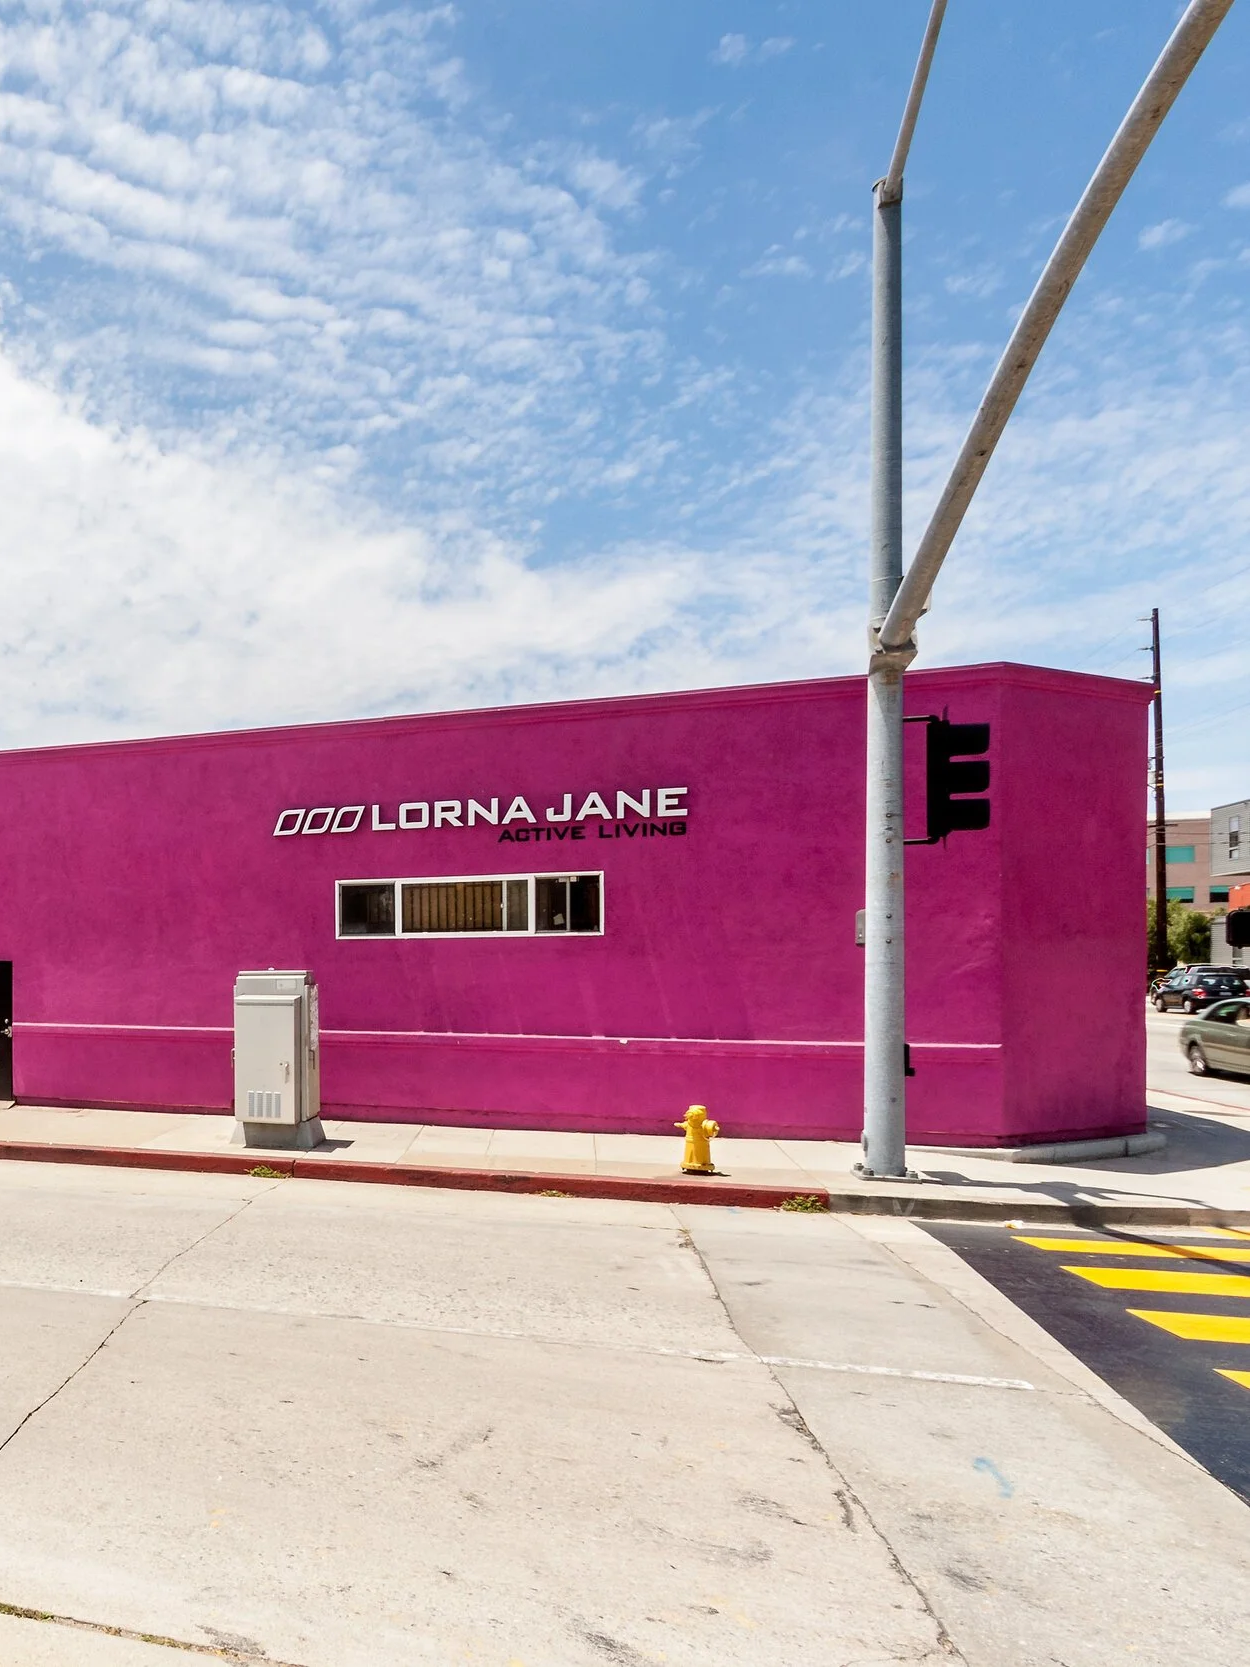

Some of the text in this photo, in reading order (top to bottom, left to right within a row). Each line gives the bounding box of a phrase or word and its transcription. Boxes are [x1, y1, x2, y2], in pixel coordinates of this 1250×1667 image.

[371, 787, 688, 831] LORNA JANE
[498, 821, 687, 843] ACTIVE LIVING
